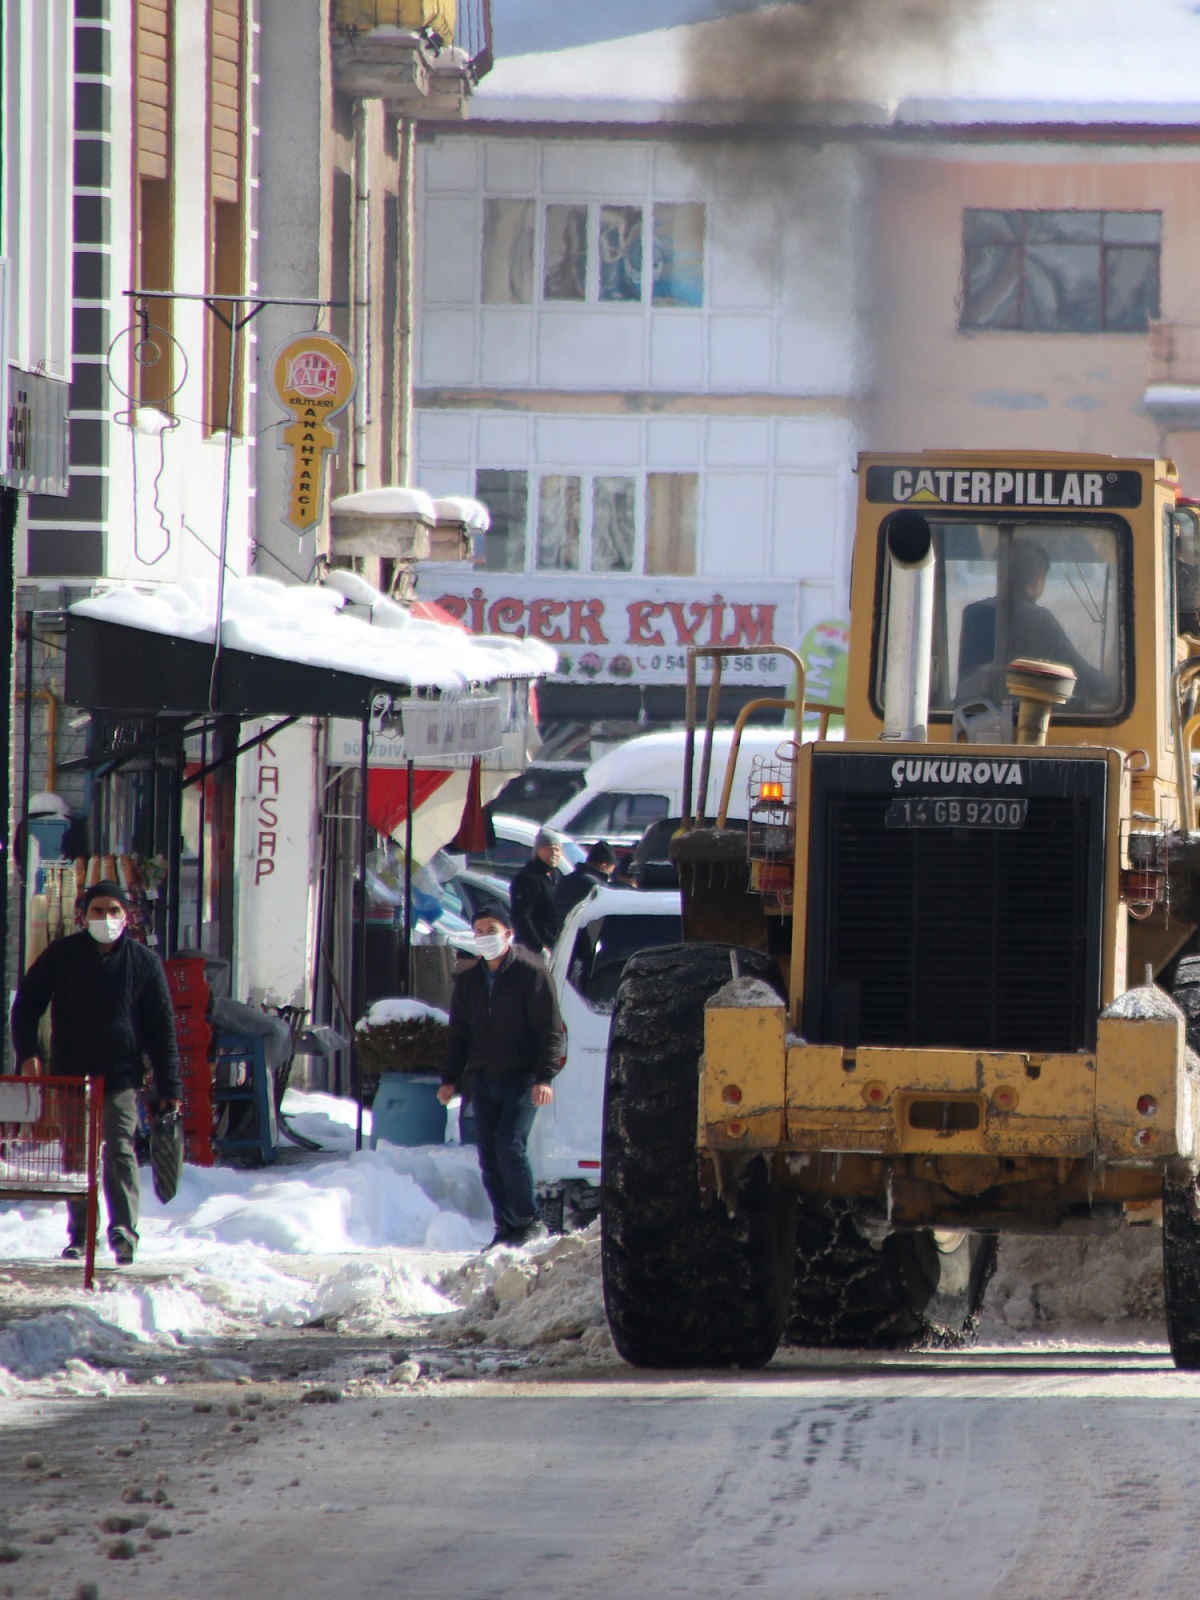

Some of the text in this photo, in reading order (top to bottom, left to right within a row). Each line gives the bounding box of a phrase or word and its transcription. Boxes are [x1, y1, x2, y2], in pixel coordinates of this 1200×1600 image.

[284, 357, 339, 395] KALE
[298, 407, 317, 517] ANAHTARCI
[893, 469, 1103, 506] CATERPILLAR
[625, 593, 779, 646] EVİM
[651, 655, 661, 670] 0
[665, 655, 688, 671] 54
[891, 760, 1023, 789] ÇUKUROVA
[255, 725, 280, 887] KASAP
[934, 802, 961, 823] GB
[966, 803, 1021, 825] 9200
